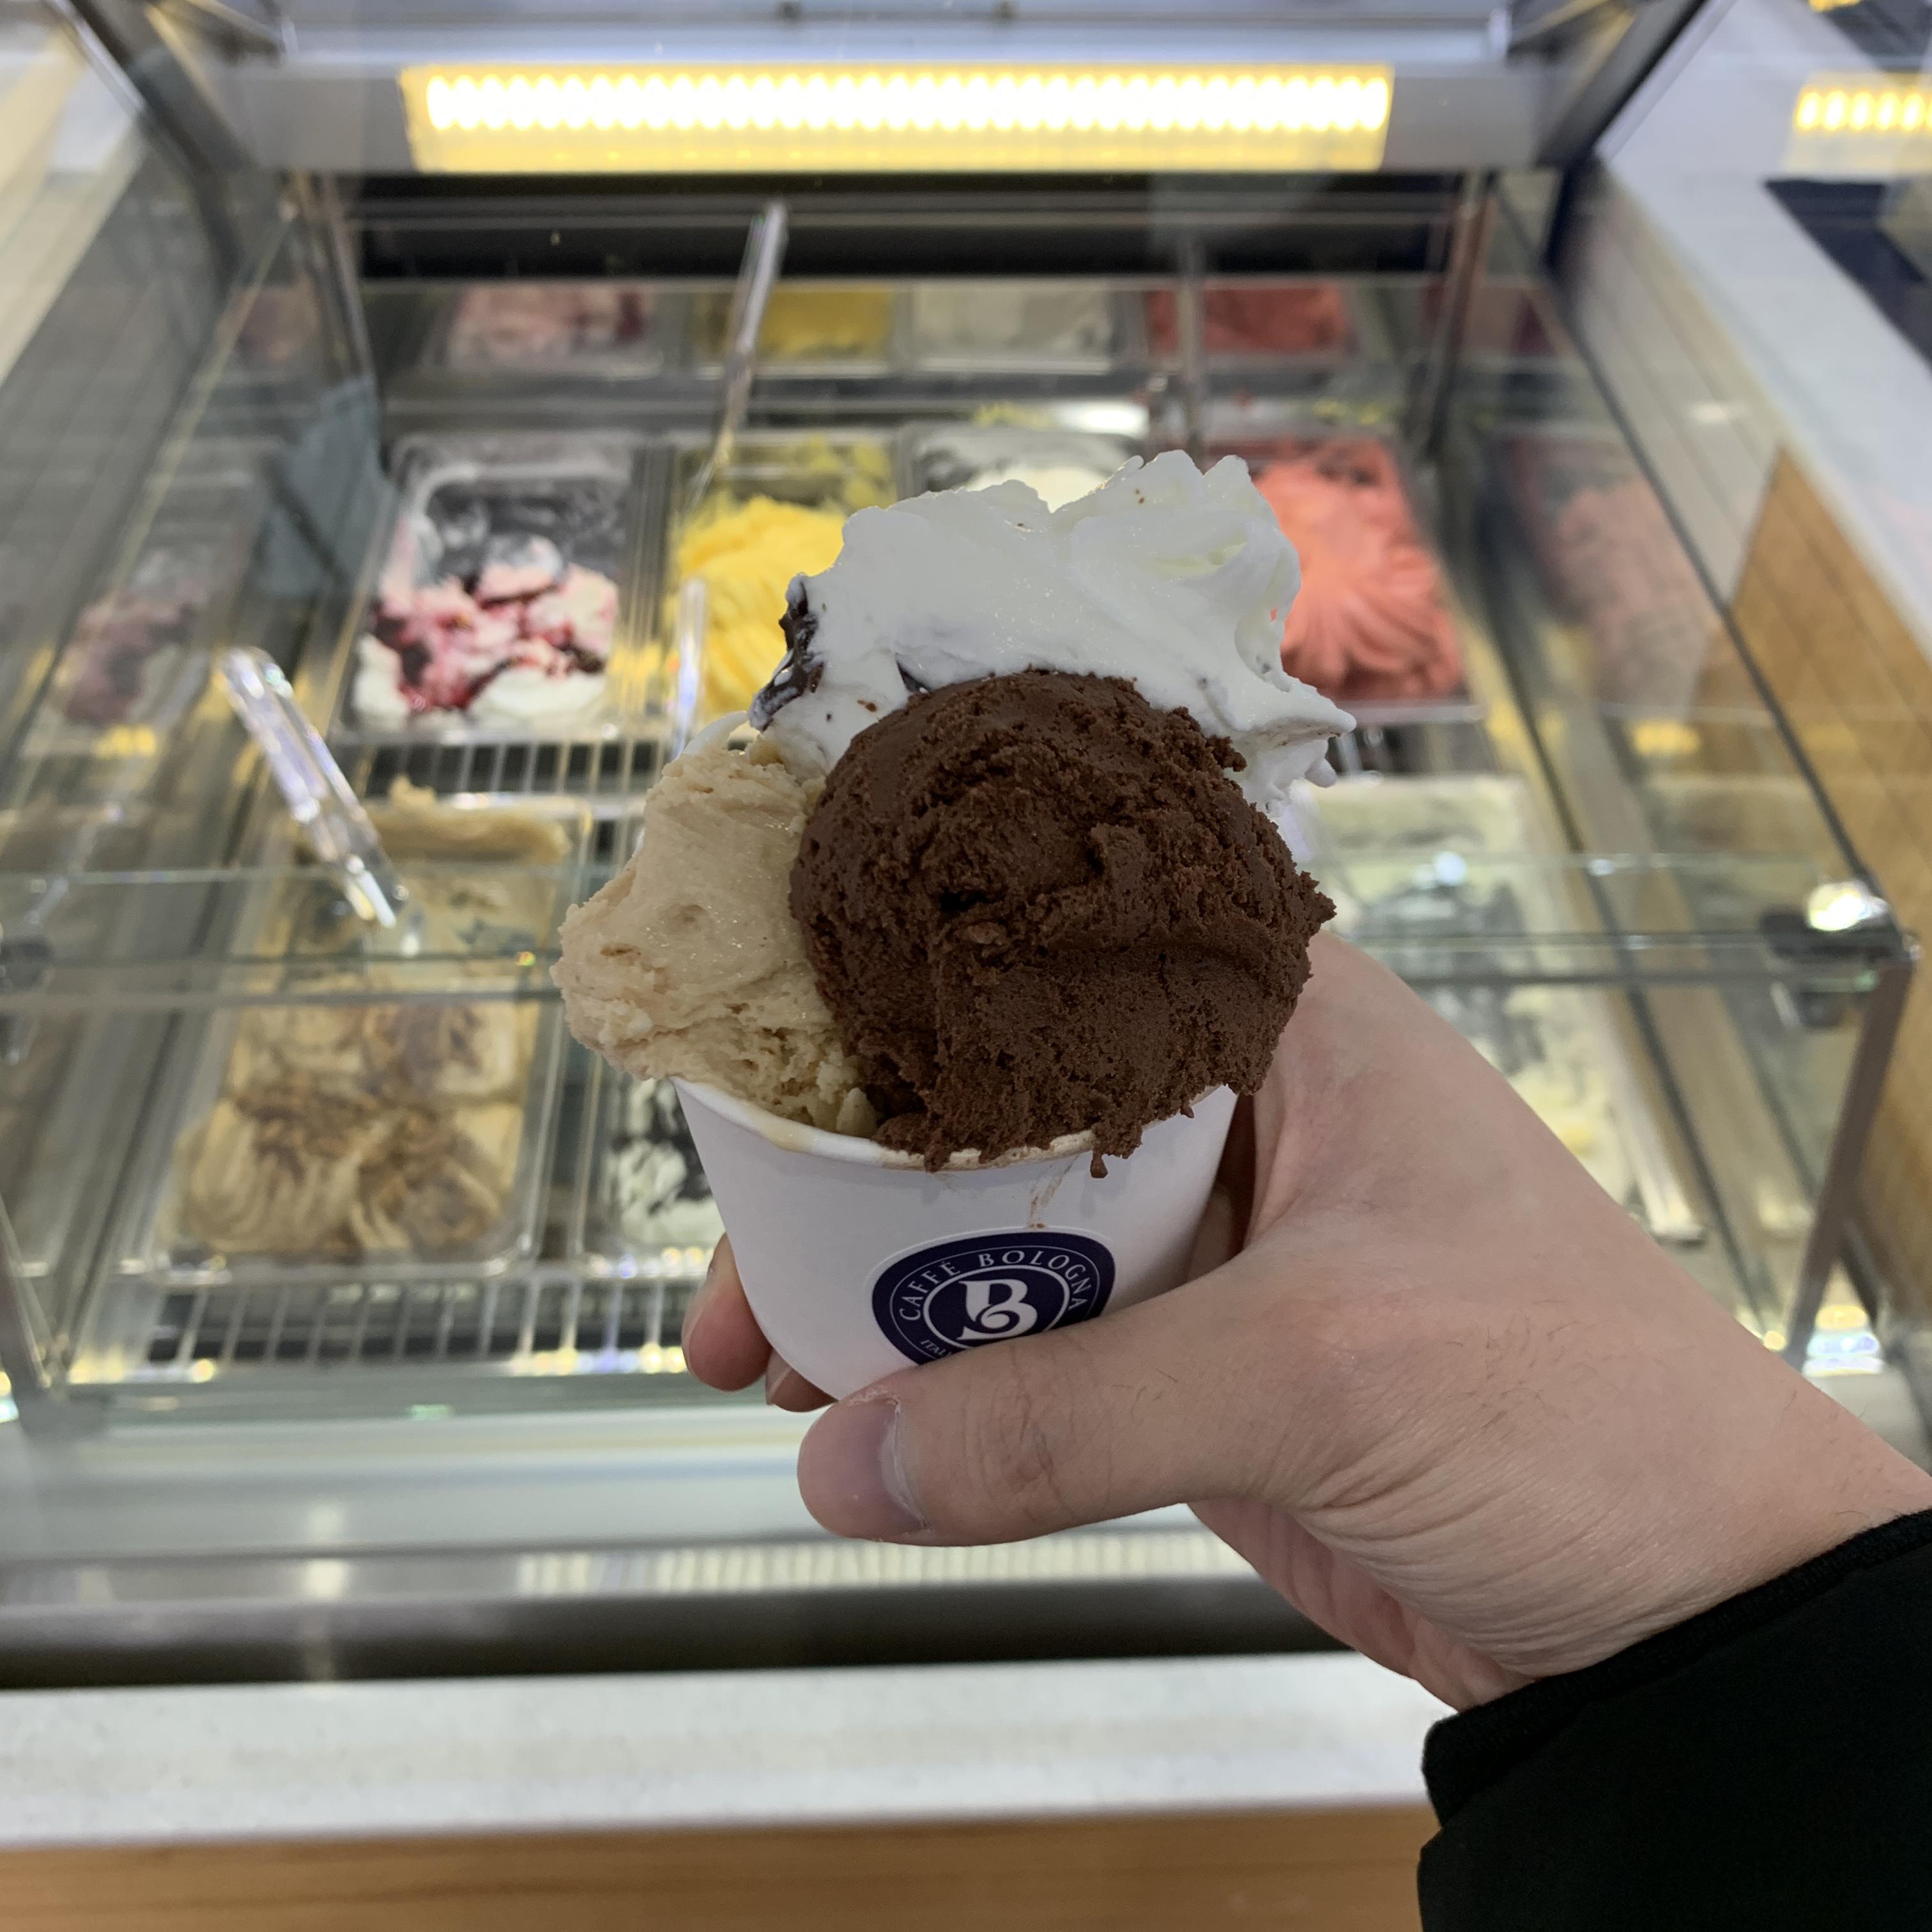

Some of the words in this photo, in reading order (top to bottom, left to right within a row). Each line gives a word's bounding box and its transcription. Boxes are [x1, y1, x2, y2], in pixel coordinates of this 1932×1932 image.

[956, 1278, 1038, 1340] B
[978, 1250, 1092, 1310] BOLOGNA
[920, 1339, 953, 1357] ITAL
